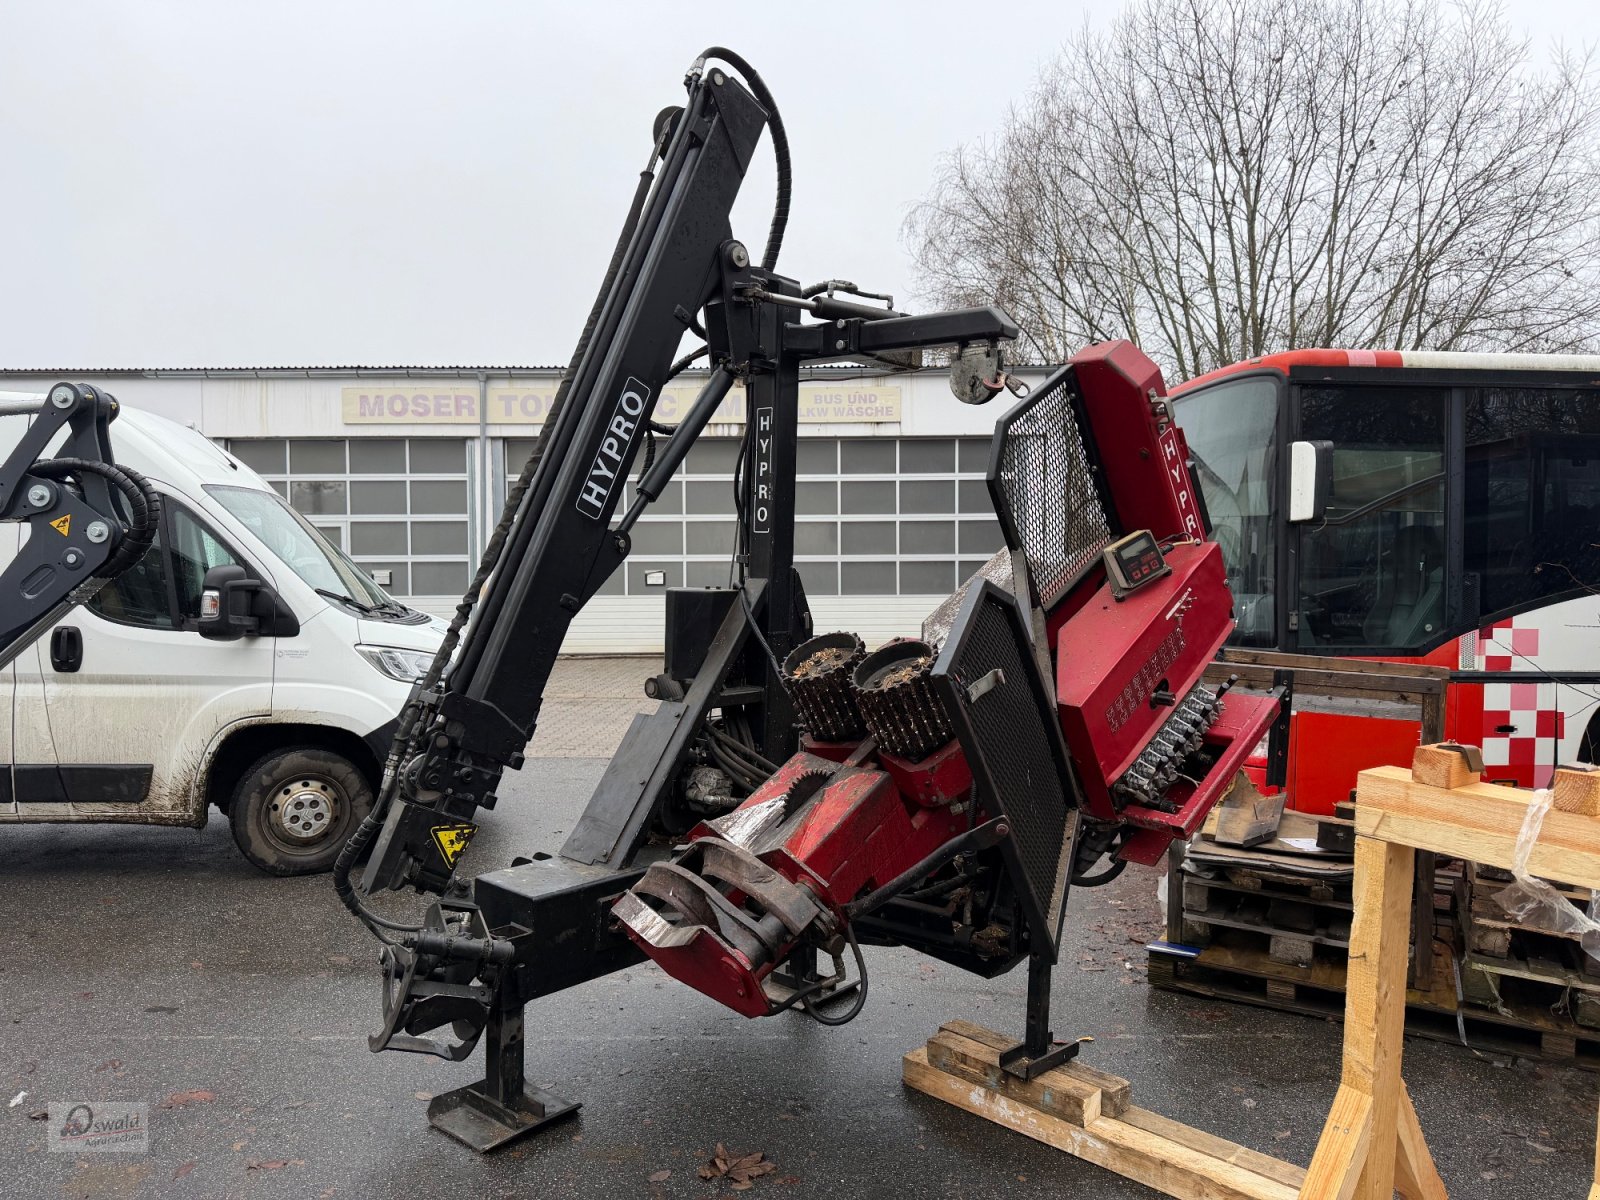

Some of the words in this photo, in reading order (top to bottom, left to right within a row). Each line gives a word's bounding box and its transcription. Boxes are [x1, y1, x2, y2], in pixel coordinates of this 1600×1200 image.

[359, 394, 476, 417] MOSER
[814, 394, 842, 404] BUS
[847, 393, 878, 404] UND
[833, 404, 894, 417] WÄSCHE
[581, 391, 643, 509] HYPRO
[757, 415, 770, 522] HYPRO
[1164, 439, 1197, 534] HYPR
